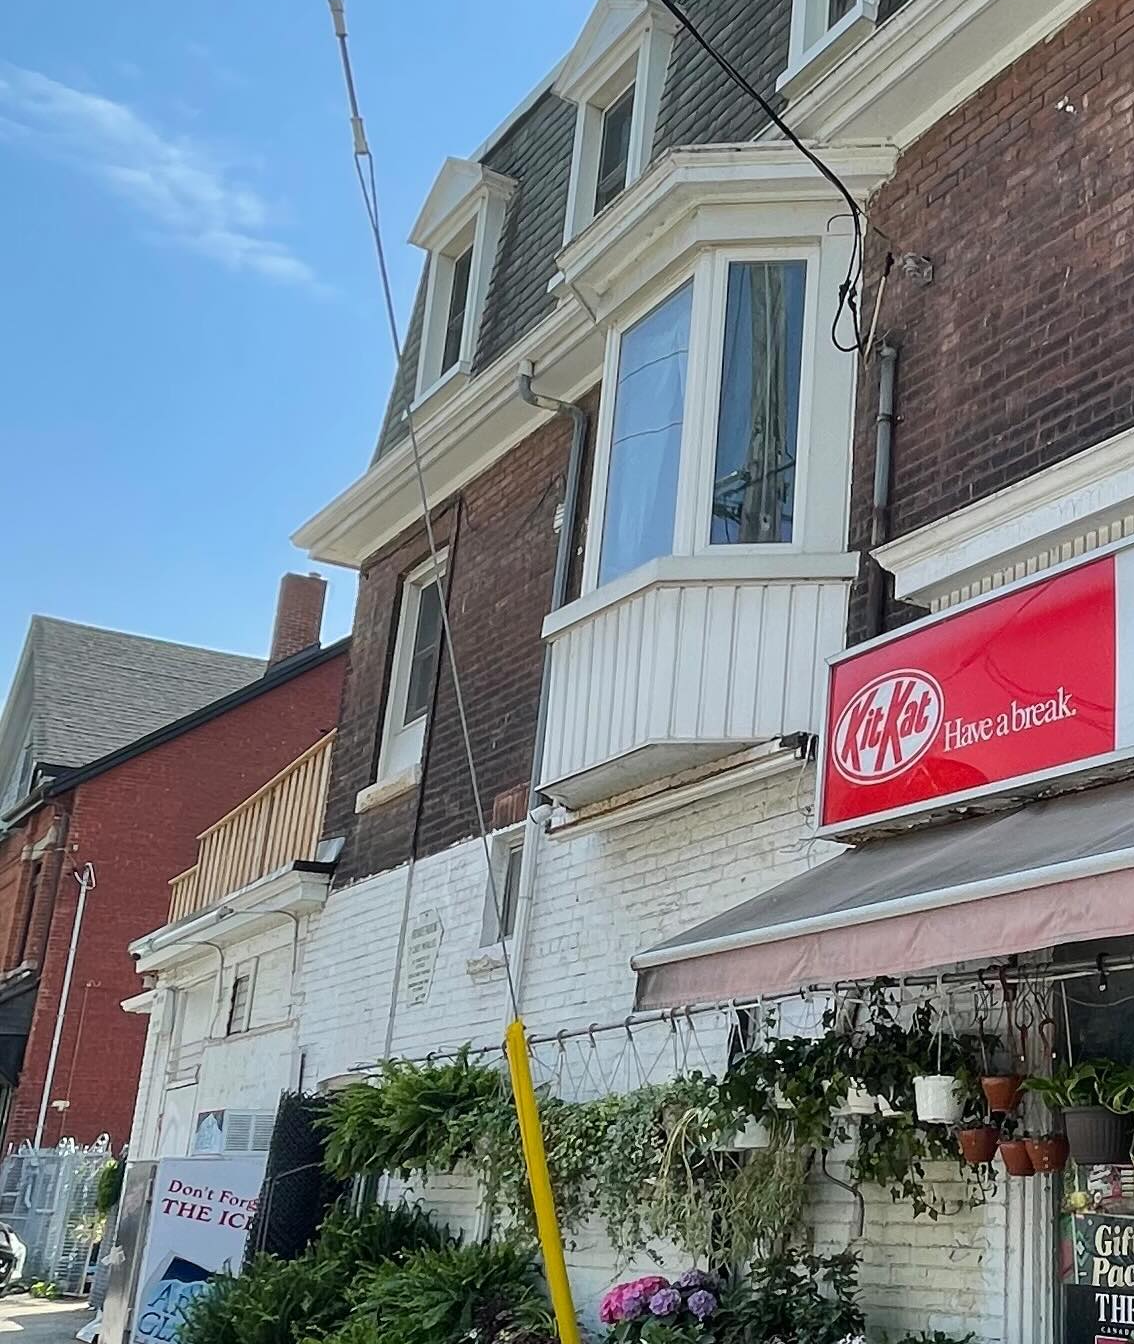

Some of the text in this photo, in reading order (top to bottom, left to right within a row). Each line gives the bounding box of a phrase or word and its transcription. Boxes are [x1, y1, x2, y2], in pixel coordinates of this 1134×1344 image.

[943, 686, 1077, 753] Have a break.
[161, 1198, 213, 1223] THE
[168, 1179, 259, 1213] Don't Forg
